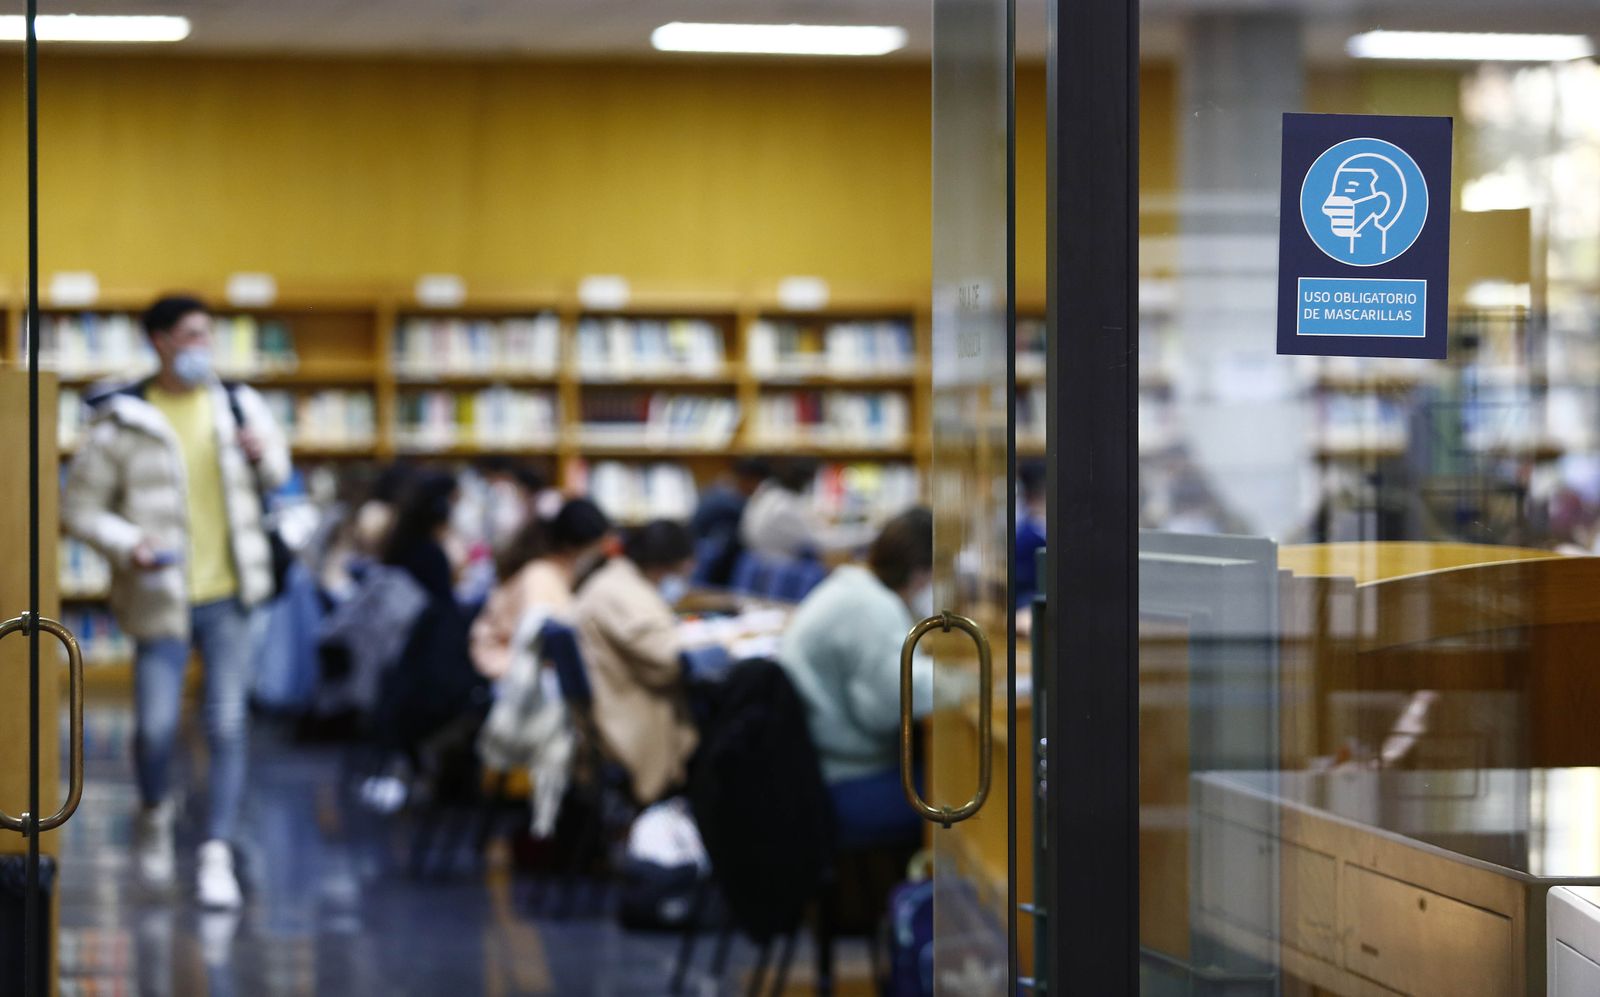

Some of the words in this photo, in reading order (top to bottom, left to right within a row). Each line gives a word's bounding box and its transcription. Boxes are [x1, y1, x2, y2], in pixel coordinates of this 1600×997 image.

[1304, 291, 1331, 303] USO
[1333, 292, 1417, 305] OBLIGATORIO
[1303, 308, 1320, 320] DE
[1324, 308, 1412, 322] MASCARILLAS
